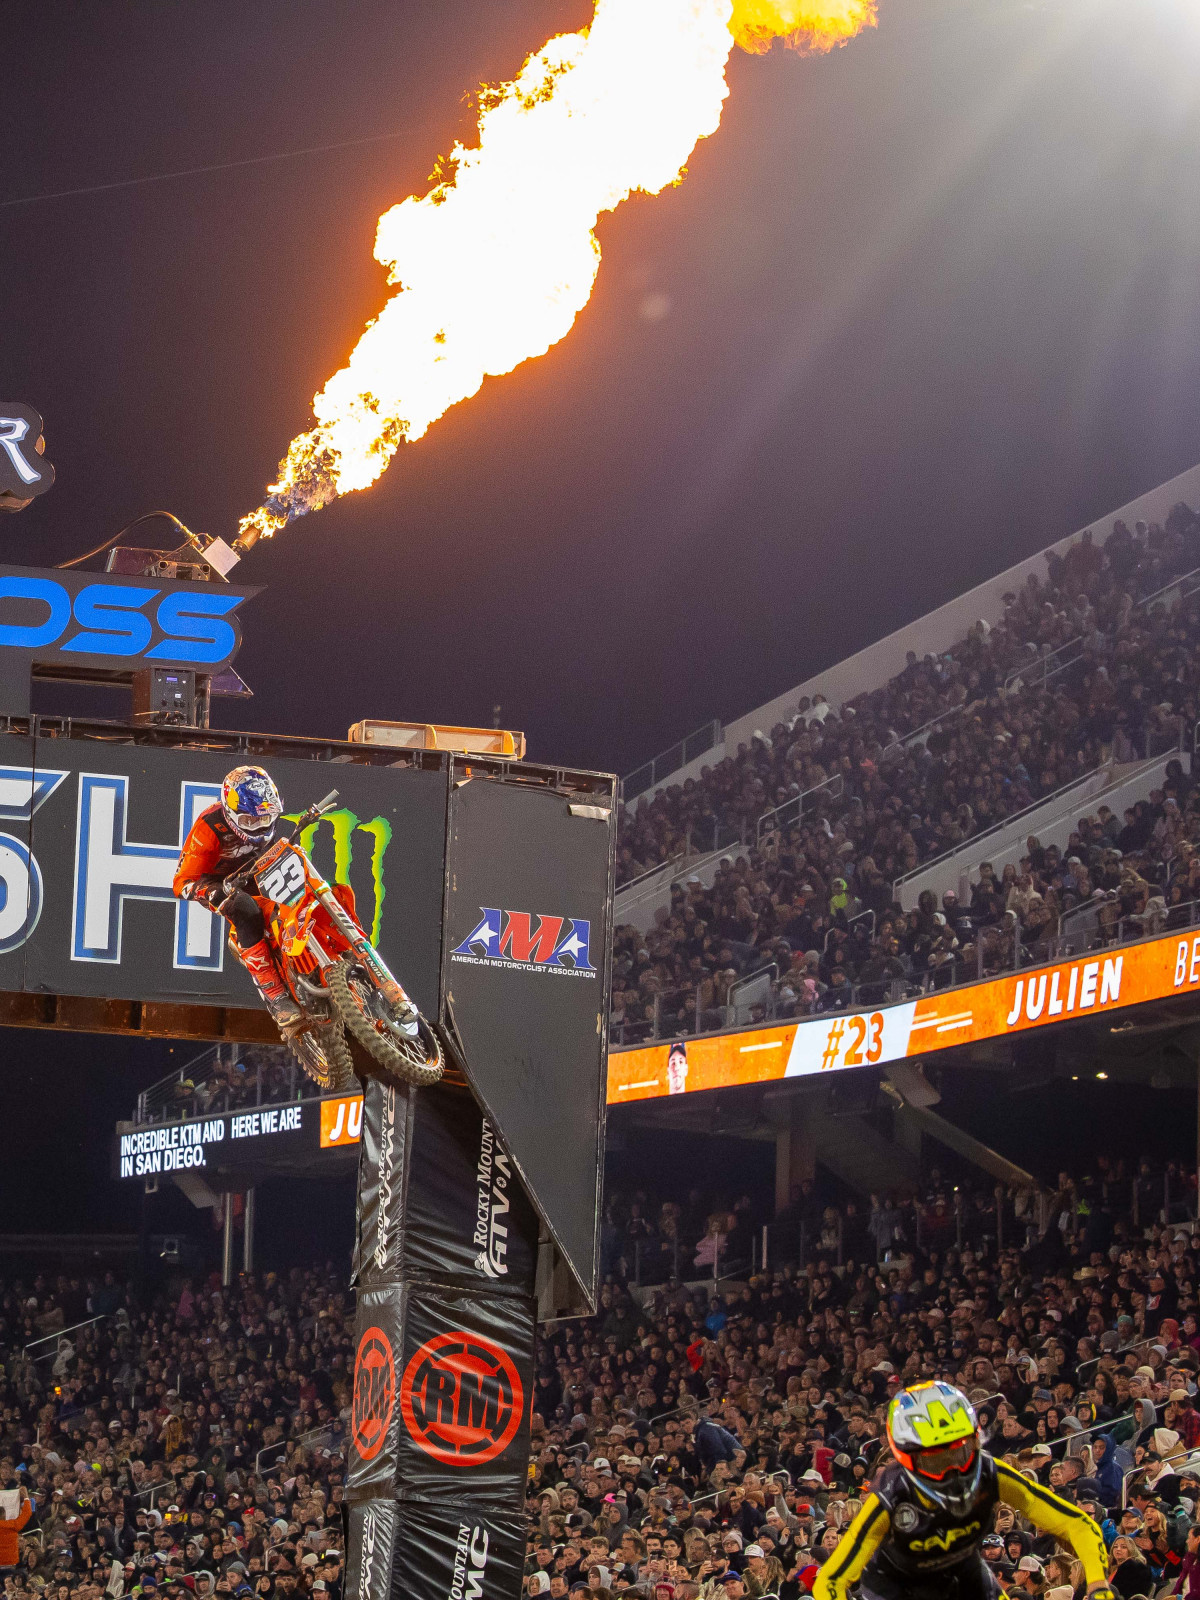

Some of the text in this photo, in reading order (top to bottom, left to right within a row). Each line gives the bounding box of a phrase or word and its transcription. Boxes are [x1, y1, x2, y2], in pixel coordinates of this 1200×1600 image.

[264, 854, 306, 904] 23
[449, 907, 598, 971] AMA
[451, 955, 596, 979] AMERICAN MOTORCYCLIST ASSOCIATION
[822, 1012, 884, 1069] #23
[1007, 956, 1124, 1026] JULIEN
[121, 1107, 302, 1157] INCREDIBLE KTM AND HERE WE ARE
[121, 1145, 207, 1178] IN SAN DIEGO.
[474, 1118, 494, 1249] ROCKY MOUNT
